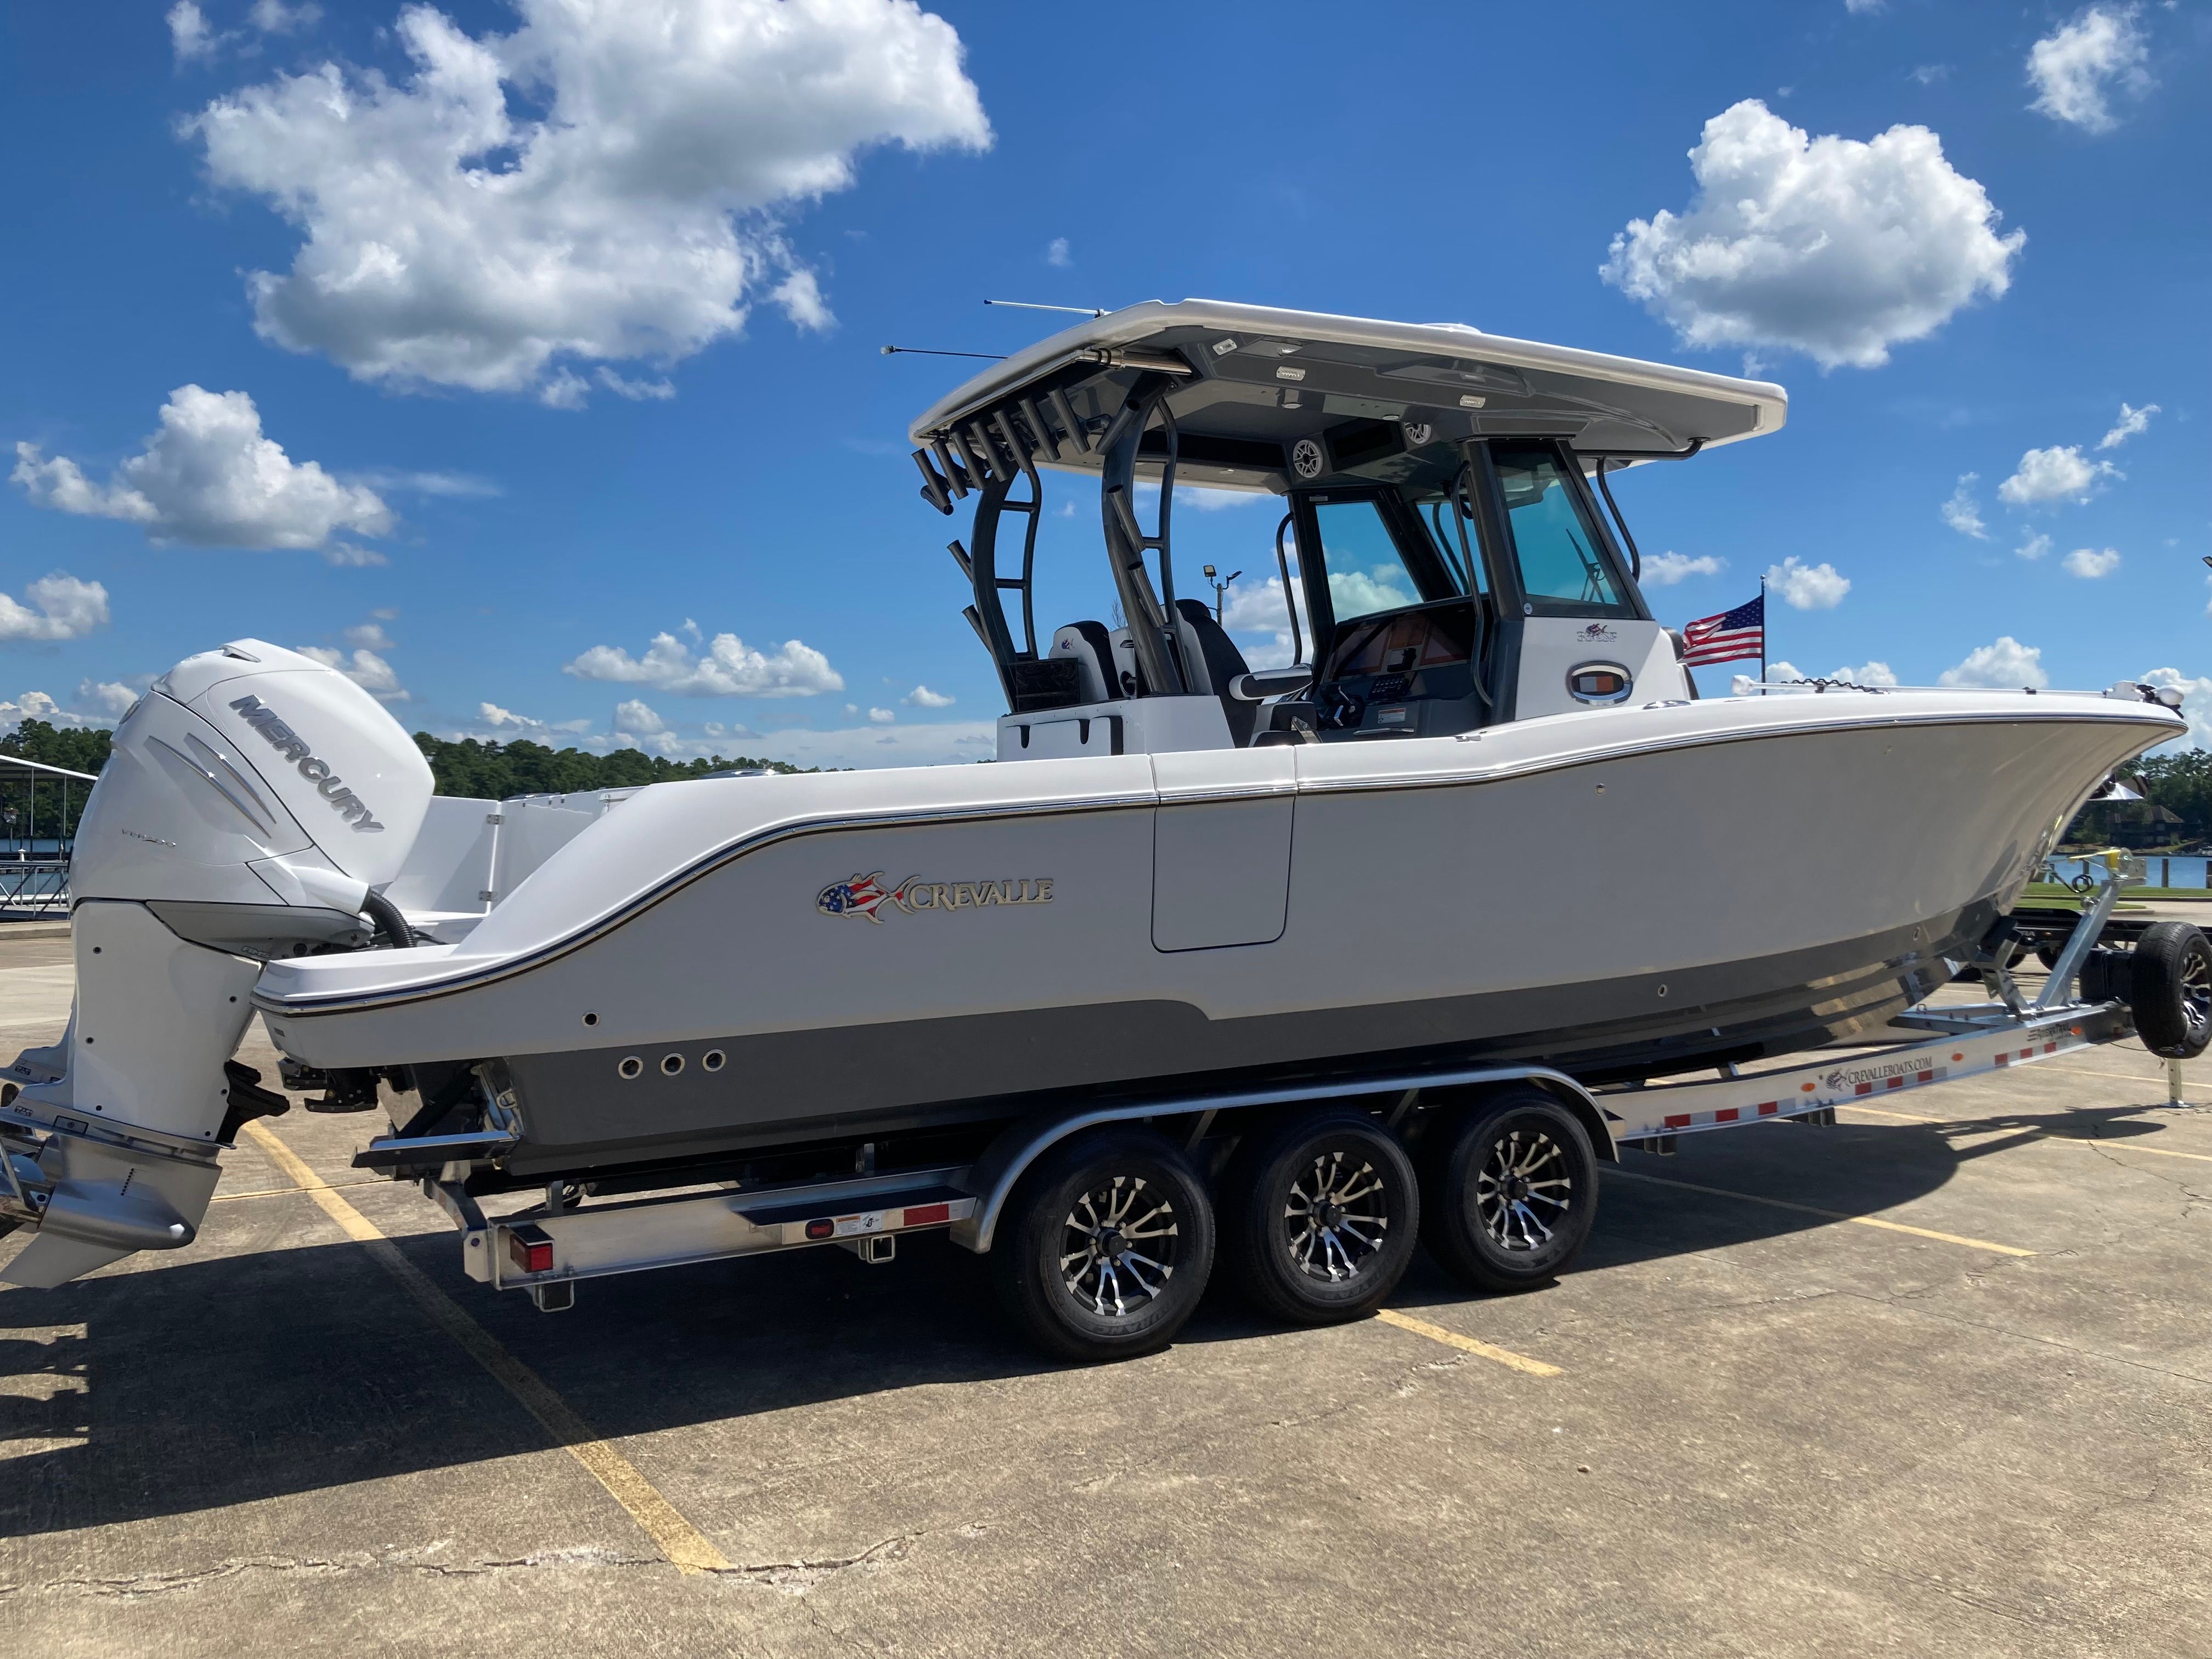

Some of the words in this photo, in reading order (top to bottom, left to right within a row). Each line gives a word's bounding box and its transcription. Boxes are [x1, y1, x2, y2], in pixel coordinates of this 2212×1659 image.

[228, 695, 385, 833] MERCURY
[909, 878, 1054, 911] CREVALLE
[1848, 1056, 1933, 1084] CREVALLEBOATS.COM
